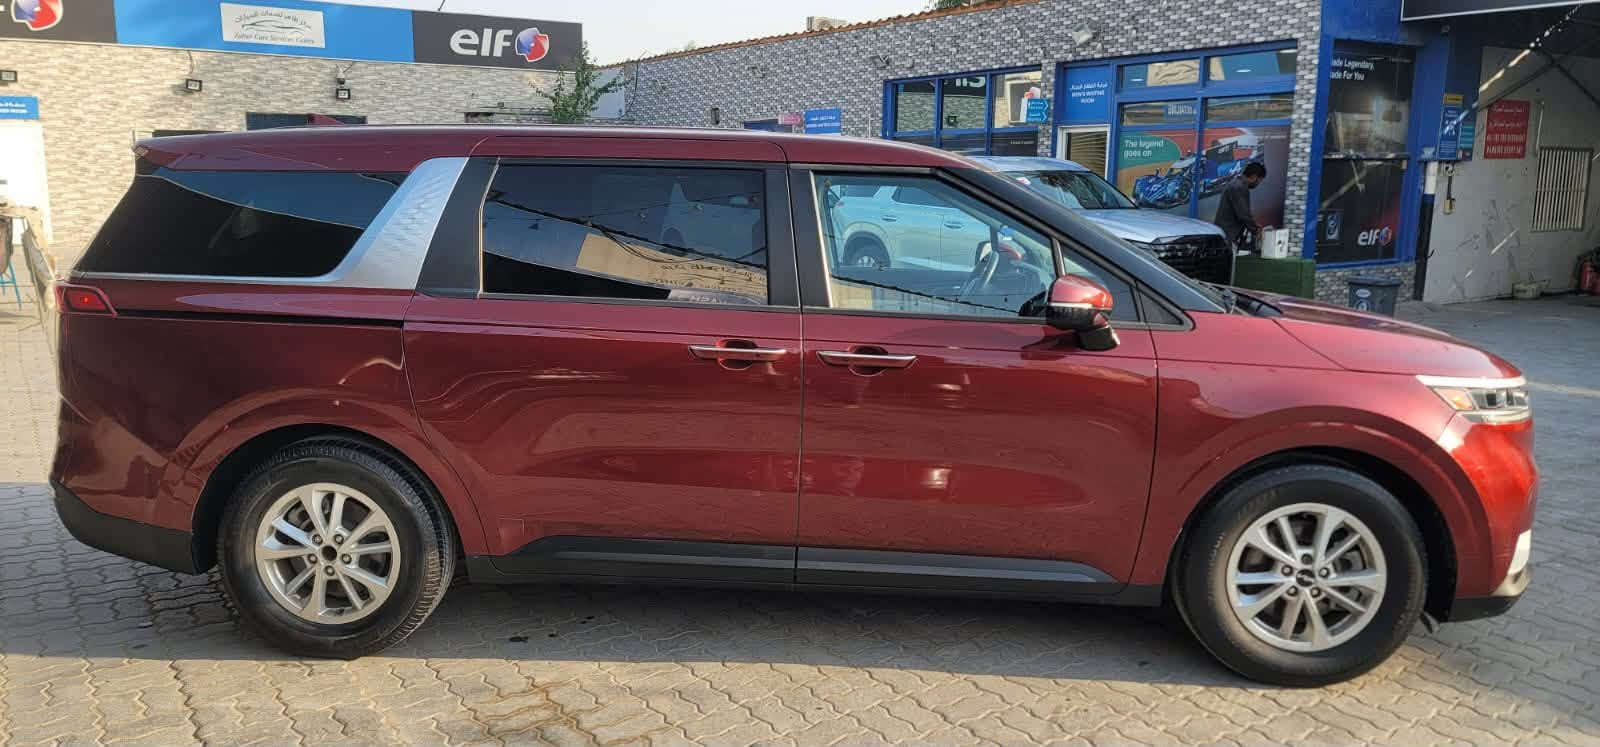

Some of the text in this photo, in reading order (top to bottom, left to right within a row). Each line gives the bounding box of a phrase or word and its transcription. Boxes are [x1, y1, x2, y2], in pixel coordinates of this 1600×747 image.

[450, 28, 513, 57] elf
[1343, 71, 1353, 80] For
[1354, 72, 1365, 81] You
[1125, 139, 1164, 150] The legend
[1124, 150, 1141, 159] goes
[1357, 228, 1380, 246] elf
